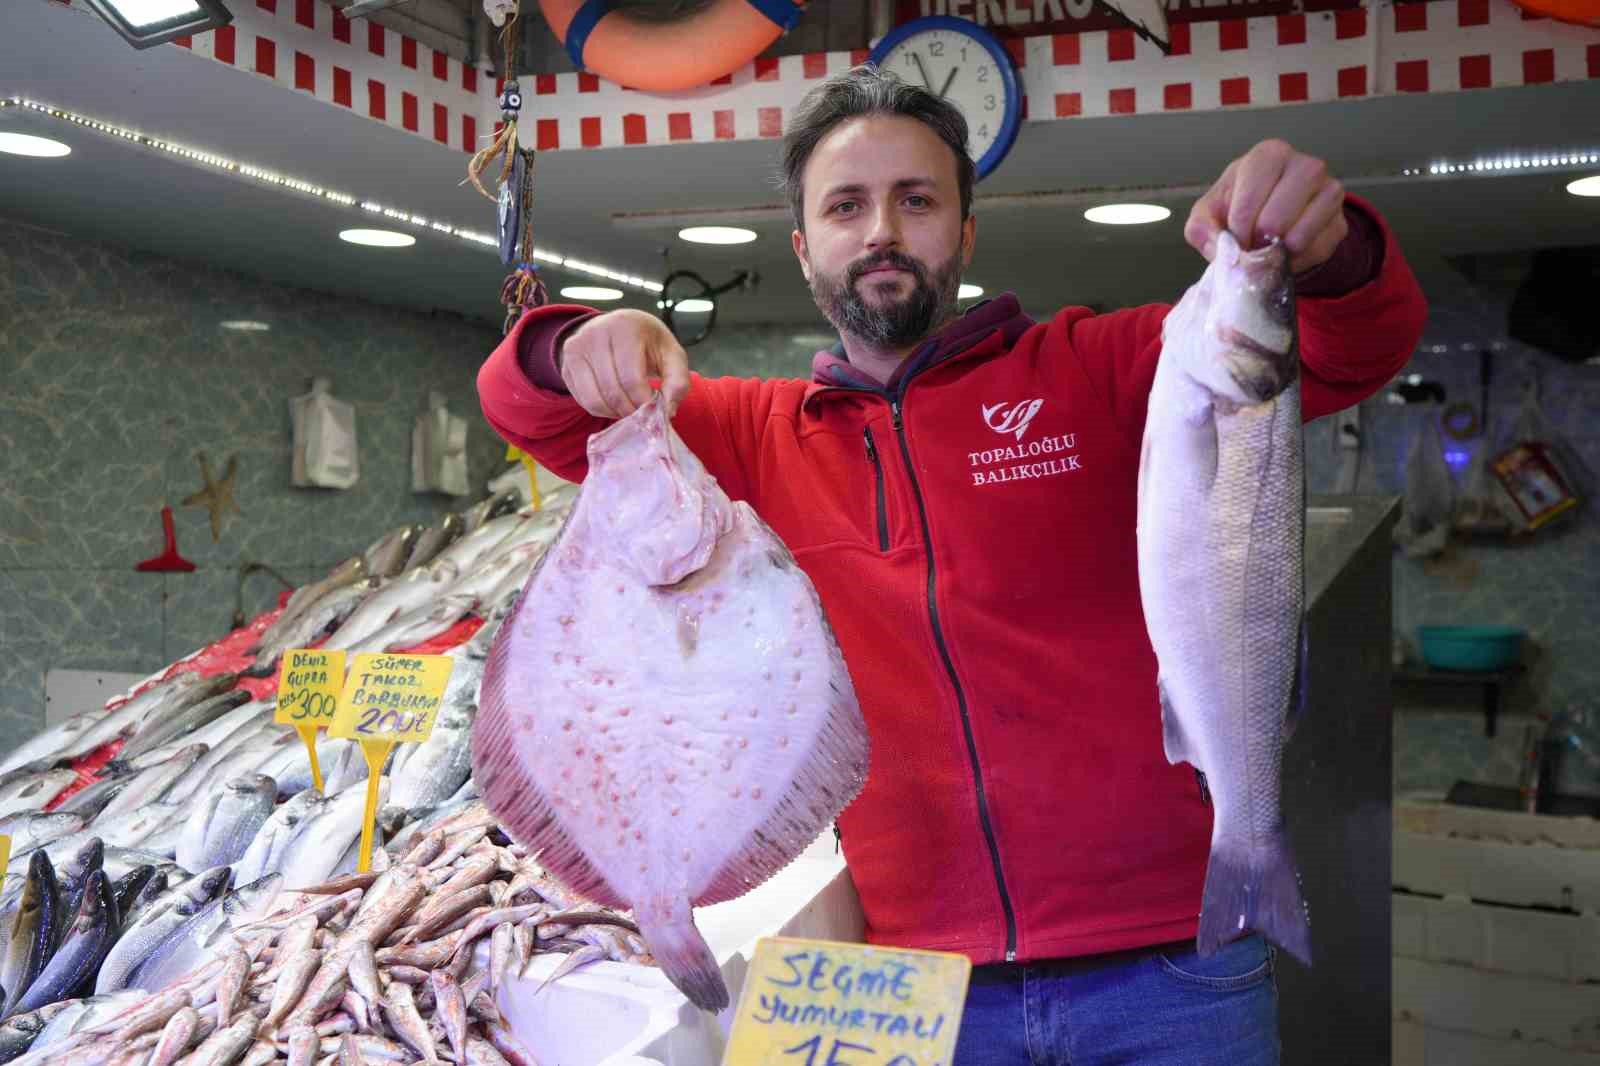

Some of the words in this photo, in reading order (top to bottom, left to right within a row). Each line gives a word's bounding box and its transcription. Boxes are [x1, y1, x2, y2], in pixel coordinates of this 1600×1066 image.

[928, 41, 945, 57] 12
[960, 47, 967, 62] 1
[977, 65, 989, 82] 2
[984, 95, 997, 111] 3
[977, 123, 989, 139] 4
[968, 433, 1078, 466] TOPALOĞLU
[972, 454, 1083, 486] BALIKÇILIK
